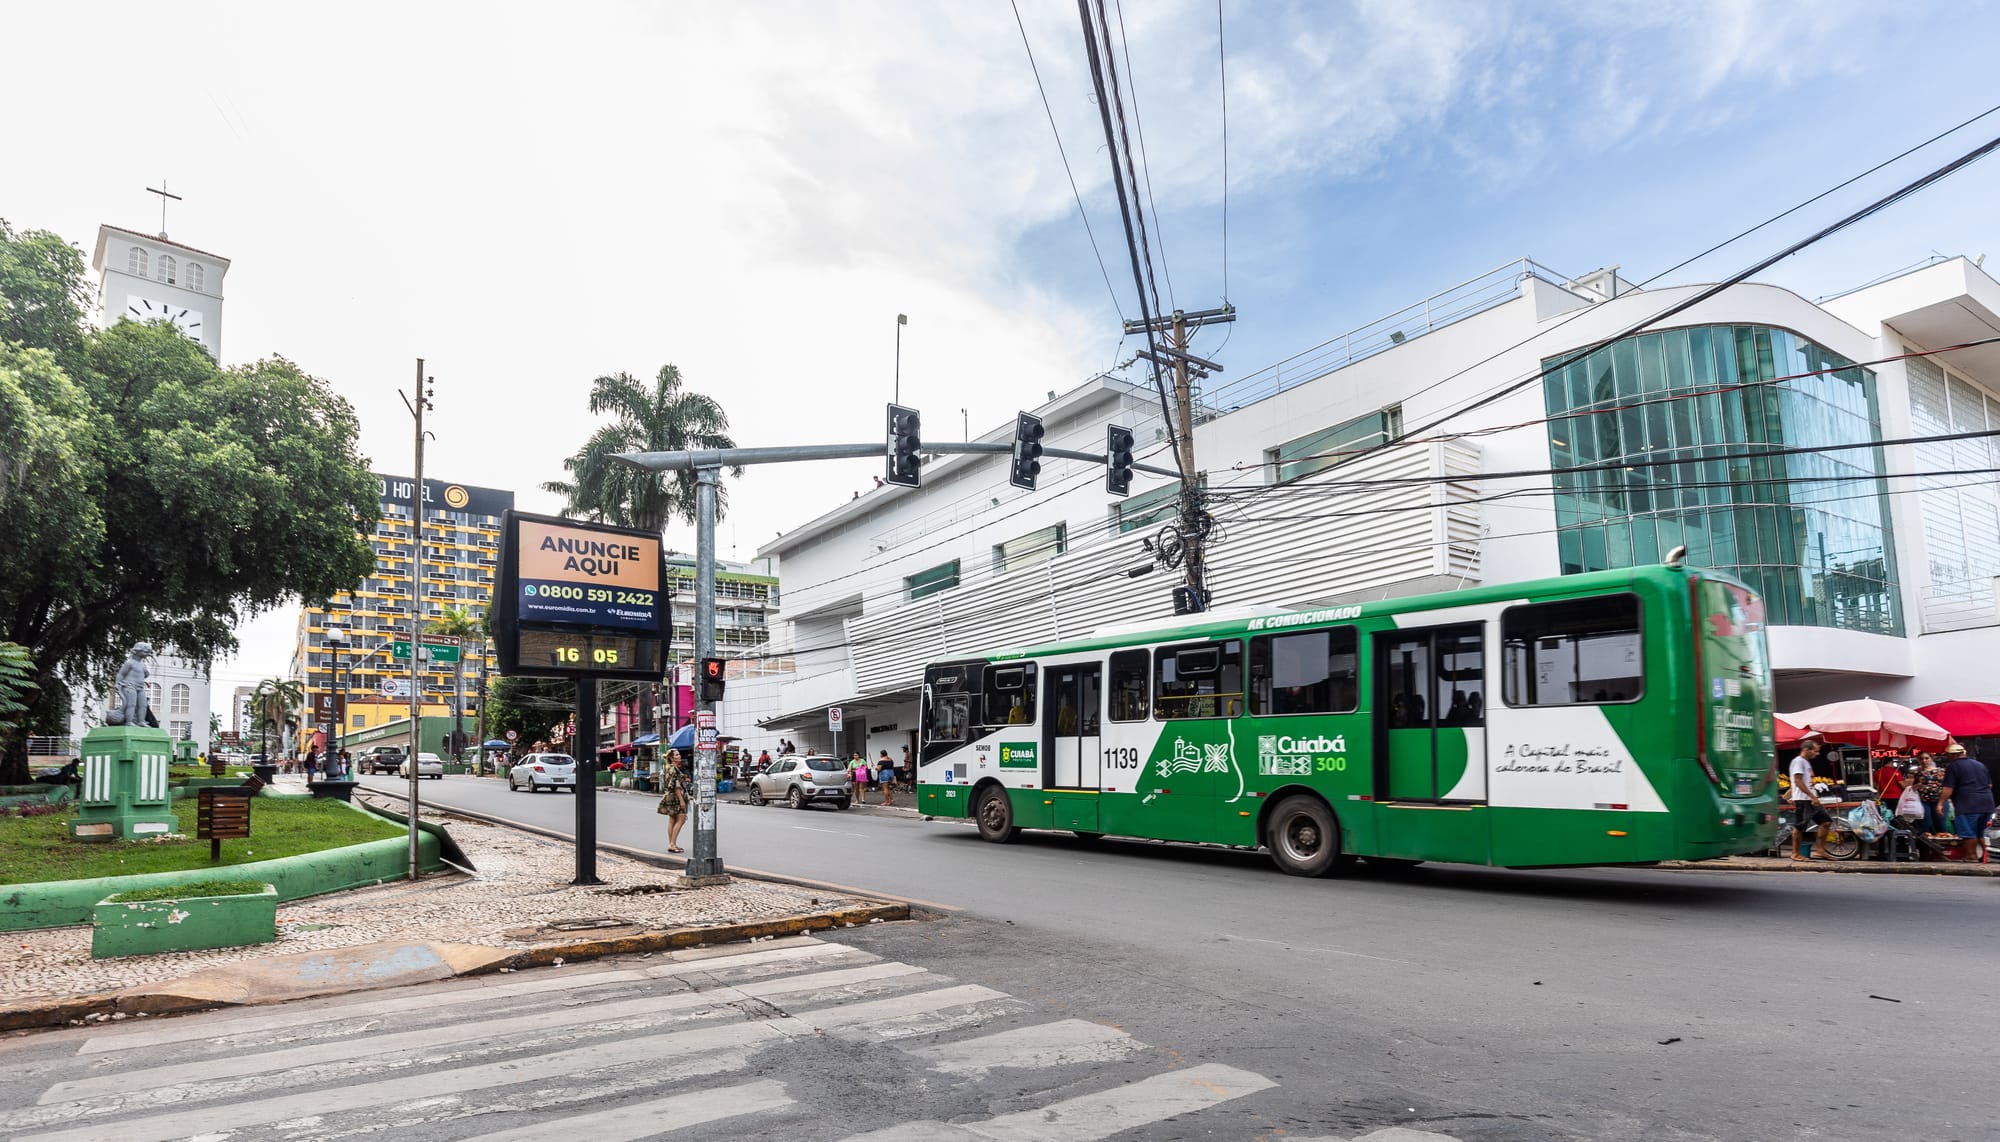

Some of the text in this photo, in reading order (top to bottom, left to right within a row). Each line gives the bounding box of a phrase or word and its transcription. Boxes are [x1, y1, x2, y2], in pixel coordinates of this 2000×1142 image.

[540, 535, 640, 561] ANUNCIE
[563, 556, 619, 576] AQUI
[539, 584, 654, 606] 0800 591 2422
[1247, 605, 1362, 631] AR CONDICIONADO
[556, 647, 618, 664] 16 05
[1277, 734, 1346, 753] Cuiabá
[1519, 744, 1570, 760] Capital
[1574, 746, 1609, 757] mais
[1010, 748, 1034, 759] CUIABÁ
[1104, 748, 1138, 769] 1139
[1316, 757, 1346, 772] 300
[1496, 759, 1550, 773] calorosa
[1576, 759, 1622, 774] Brasil
